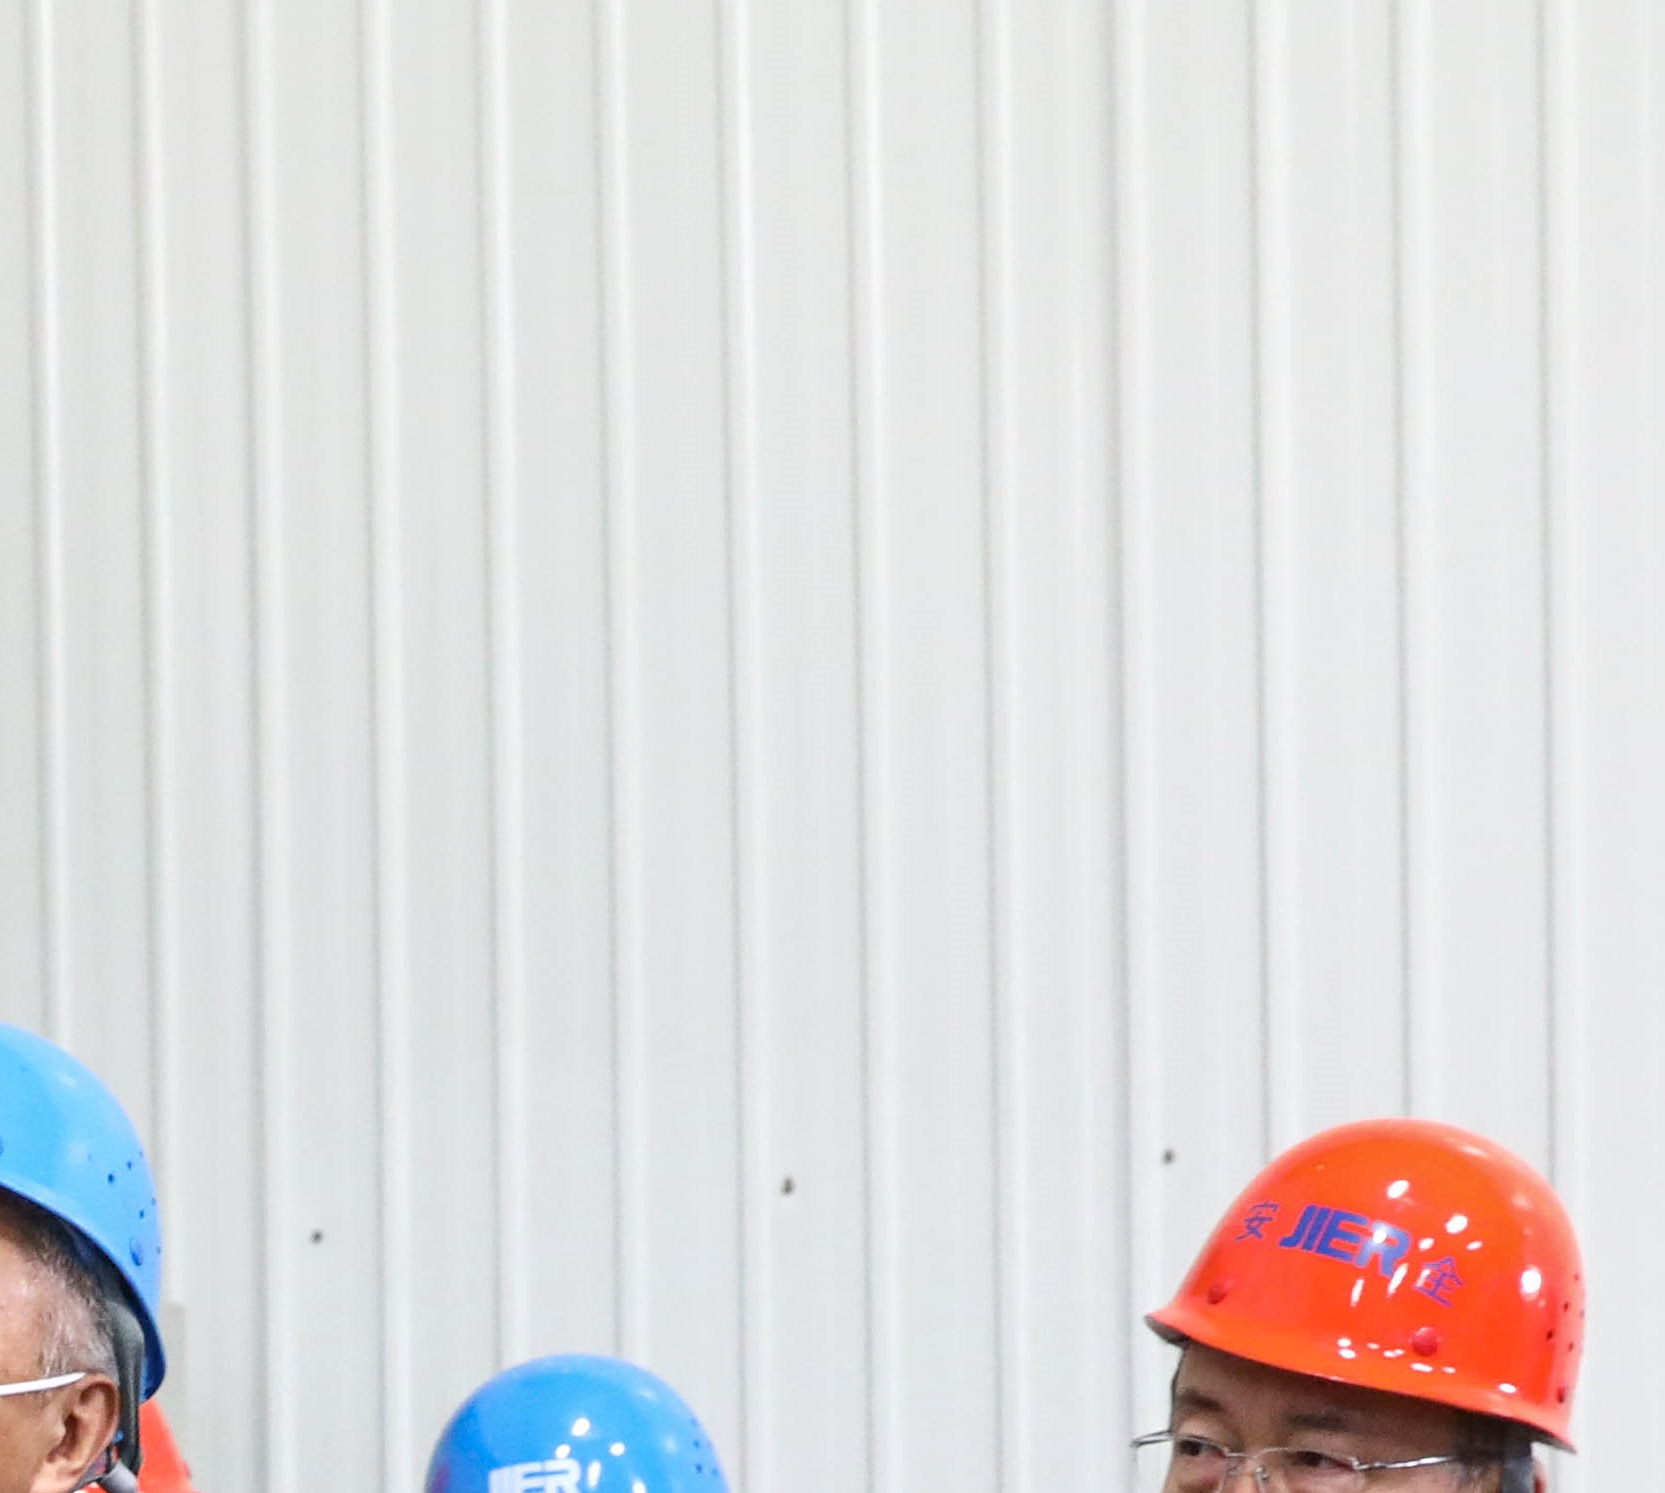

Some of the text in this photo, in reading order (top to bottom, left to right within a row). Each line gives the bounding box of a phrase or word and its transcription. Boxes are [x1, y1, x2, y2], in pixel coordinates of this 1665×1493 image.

[1236, 1200, 1463, 1307] 安 JIER 全
